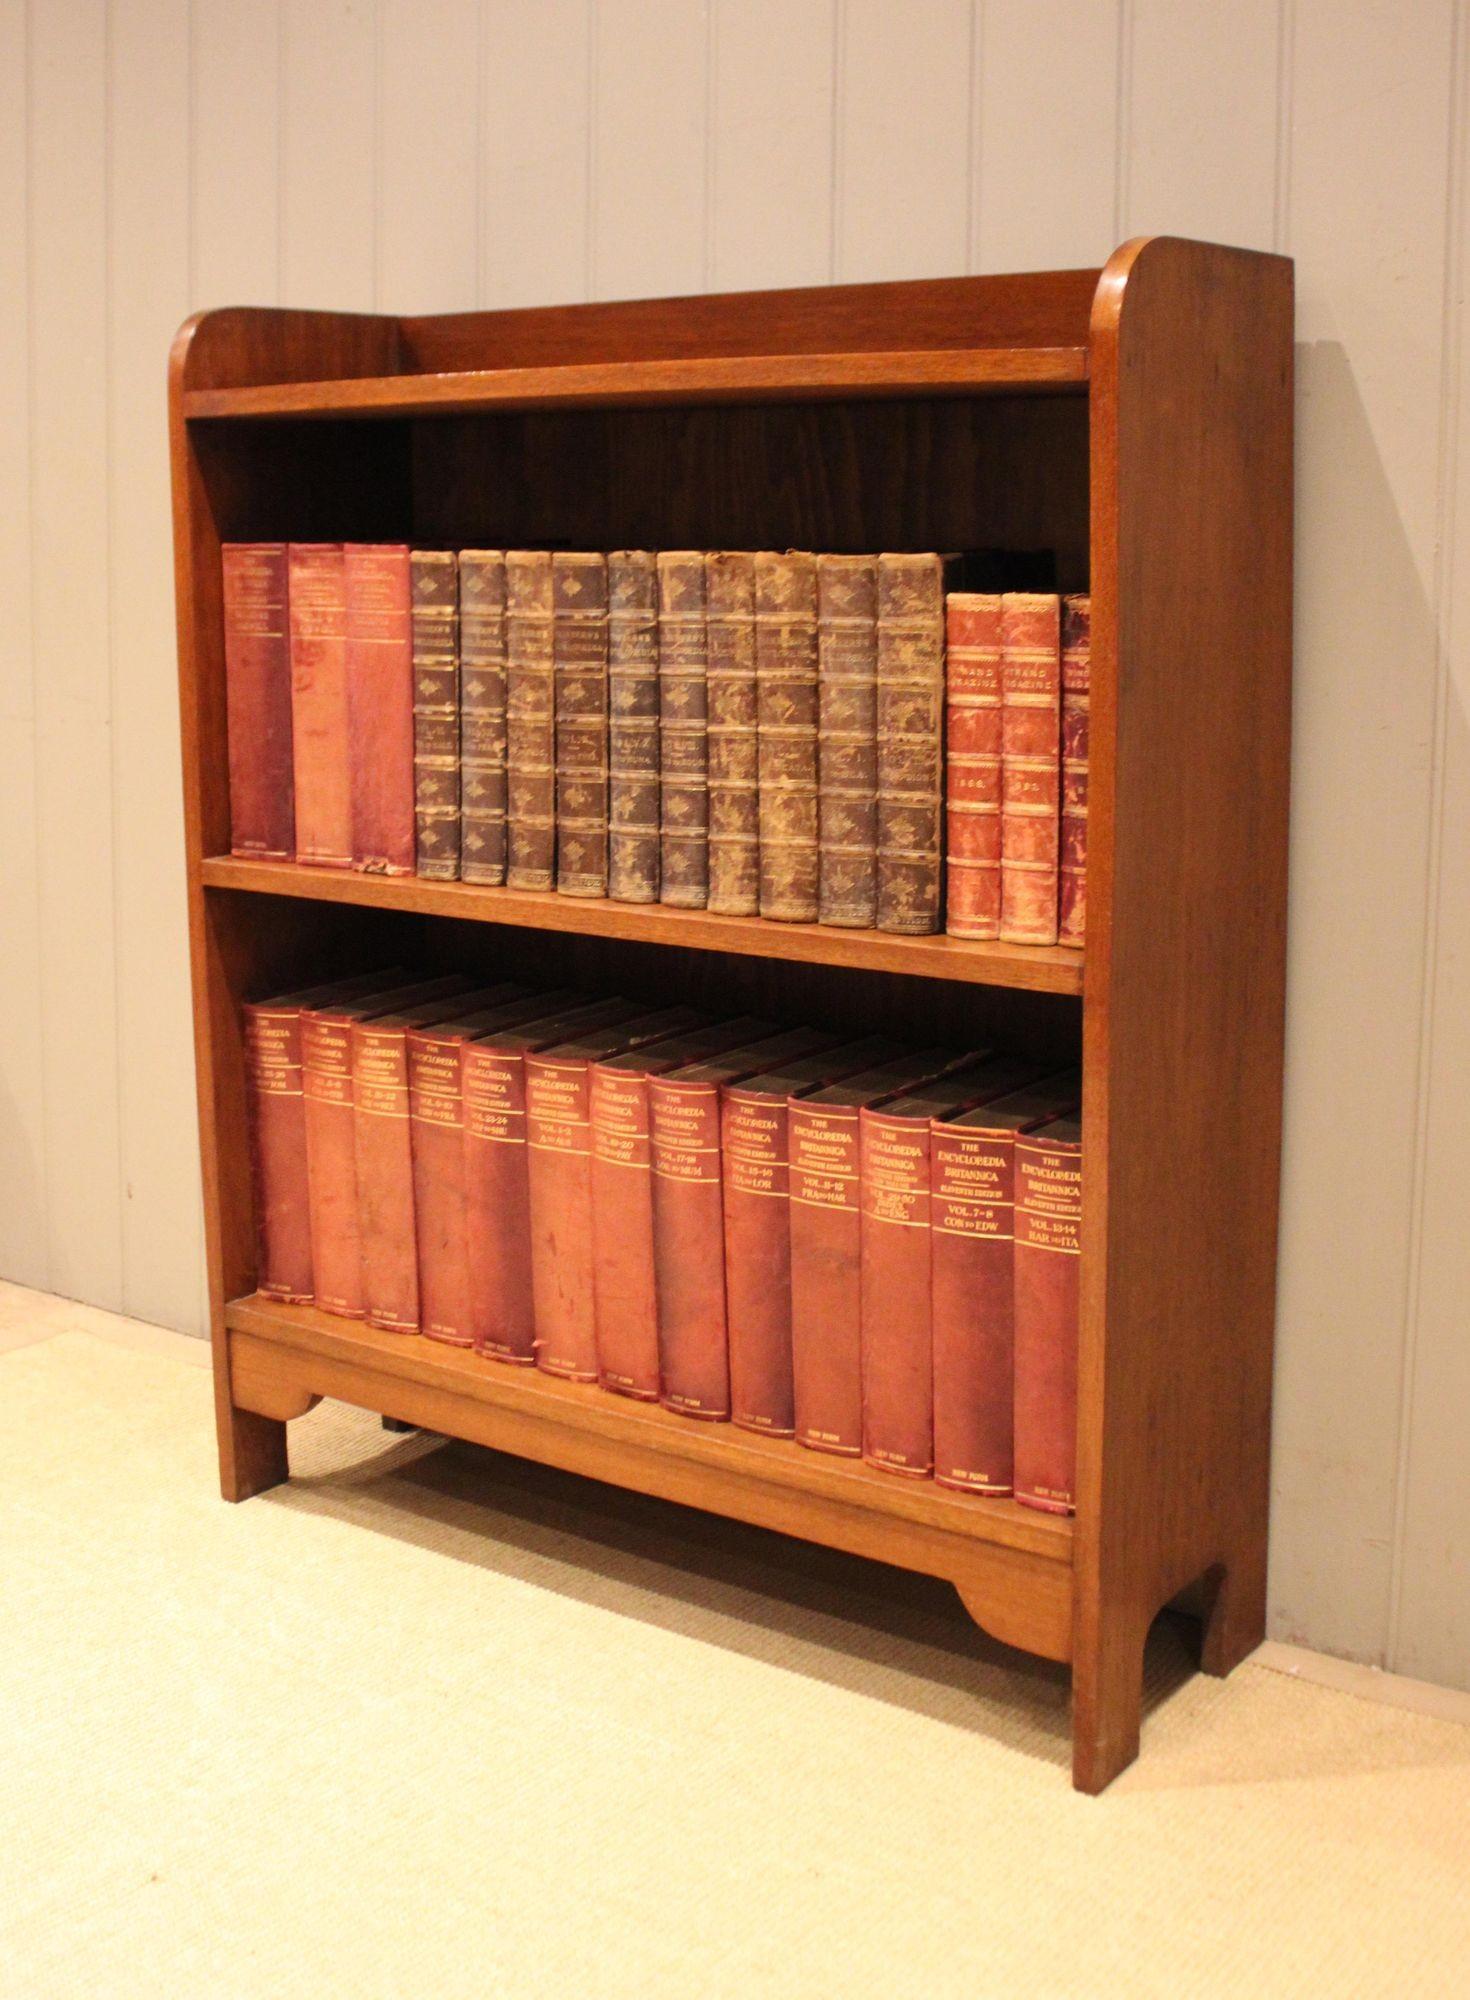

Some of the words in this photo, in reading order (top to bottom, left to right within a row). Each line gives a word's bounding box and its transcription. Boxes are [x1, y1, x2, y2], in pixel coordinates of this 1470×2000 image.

[544, 1070, 558, 1079] THE
[666, 1094, 681, 1103] THE
[740, 1106, 755, 1115] THE
[811, 1119, 828, 1129] THE
[880, 1131, 897, 1141] THE
[961, 1143, 979, 1152] THE
[1042, 1156, 1061, 1167] THE
[944, 1166, 999, 1182] BRITANNICA
[1028, 1179, 1081, 1197] BRITANNICA
[948, 1204, 971, 1217] VOL.
[975, 1219, 999, 1232] EDW
[1029, 1218, 1052, 1231] VOL.
[1060, 1235, 1079, 1248] ITA
